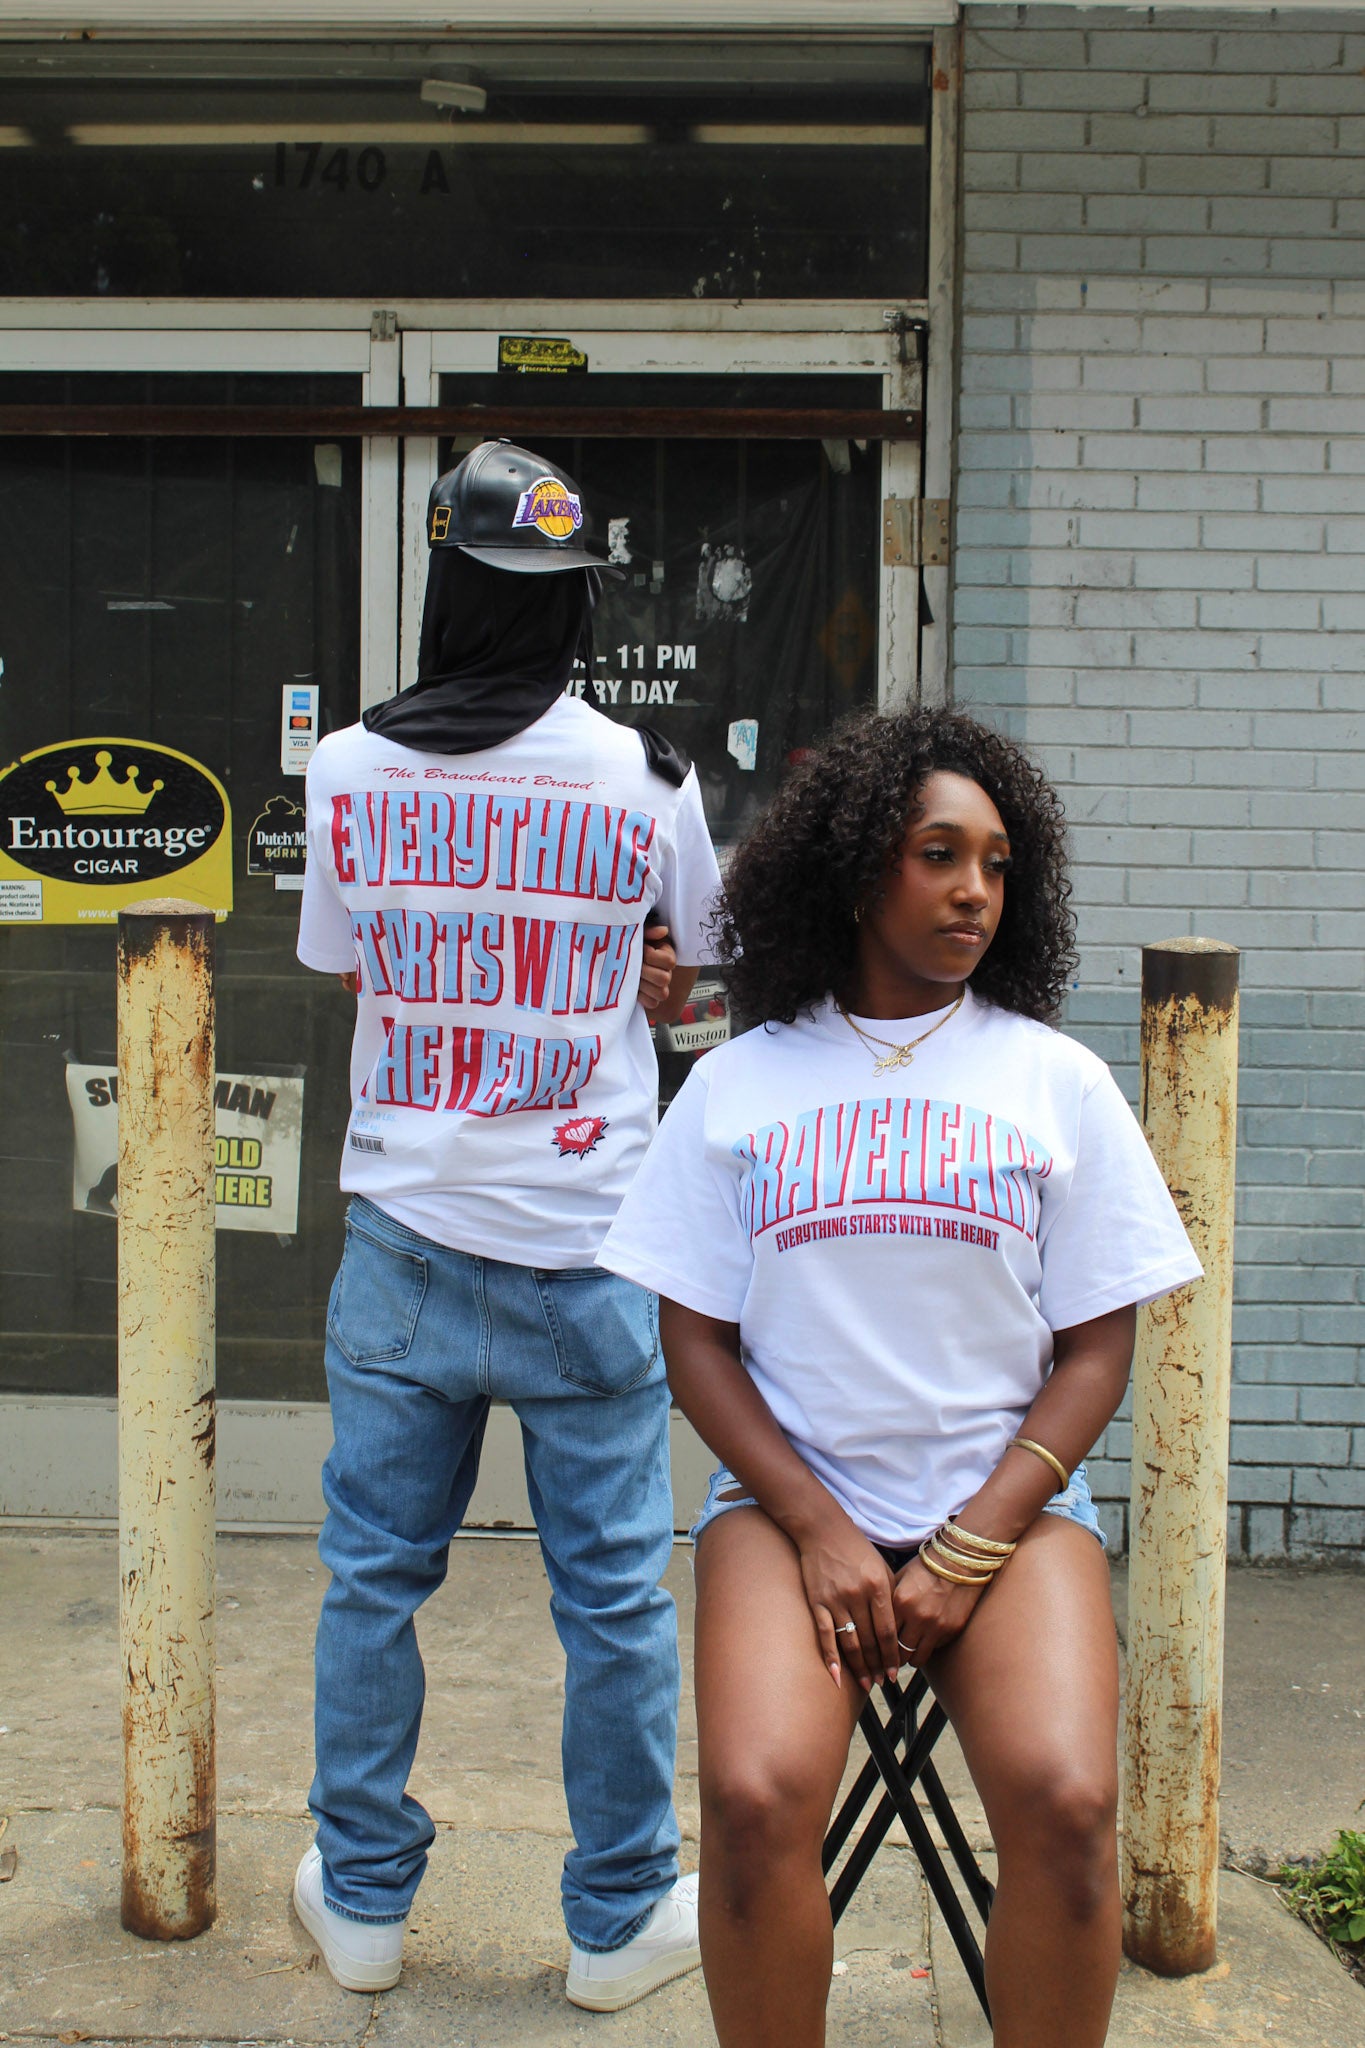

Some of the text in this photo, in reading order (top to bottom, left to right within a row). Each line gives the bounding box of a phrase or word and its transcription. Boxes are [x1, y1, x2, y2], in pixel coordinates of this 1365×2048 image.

[275, 142, 450, 194] 1740 A
[516, 493, 581, 527] LAKERS
[617, 645, 644, 669] 11
[657, 645, 696, 669] PM
[631, 680, 679, 704] DAY
[424, 768, 527, 785] Braveheart
[8, 816, 206, 857] Entourage
[265, 847, 298, 859] BURN
[331, 791, 656, 904] EVERYTHING
[74, 859, 139, 874] CIGAR
[346, 909, 639, 1015] TARTS WITH
[675, 1028, 727, 1047] Winston
[442, 1025, 602, 1118] HEART
[775, 1213, 1000, 1253] EVERYTHING STARTS WITH THE HEART
